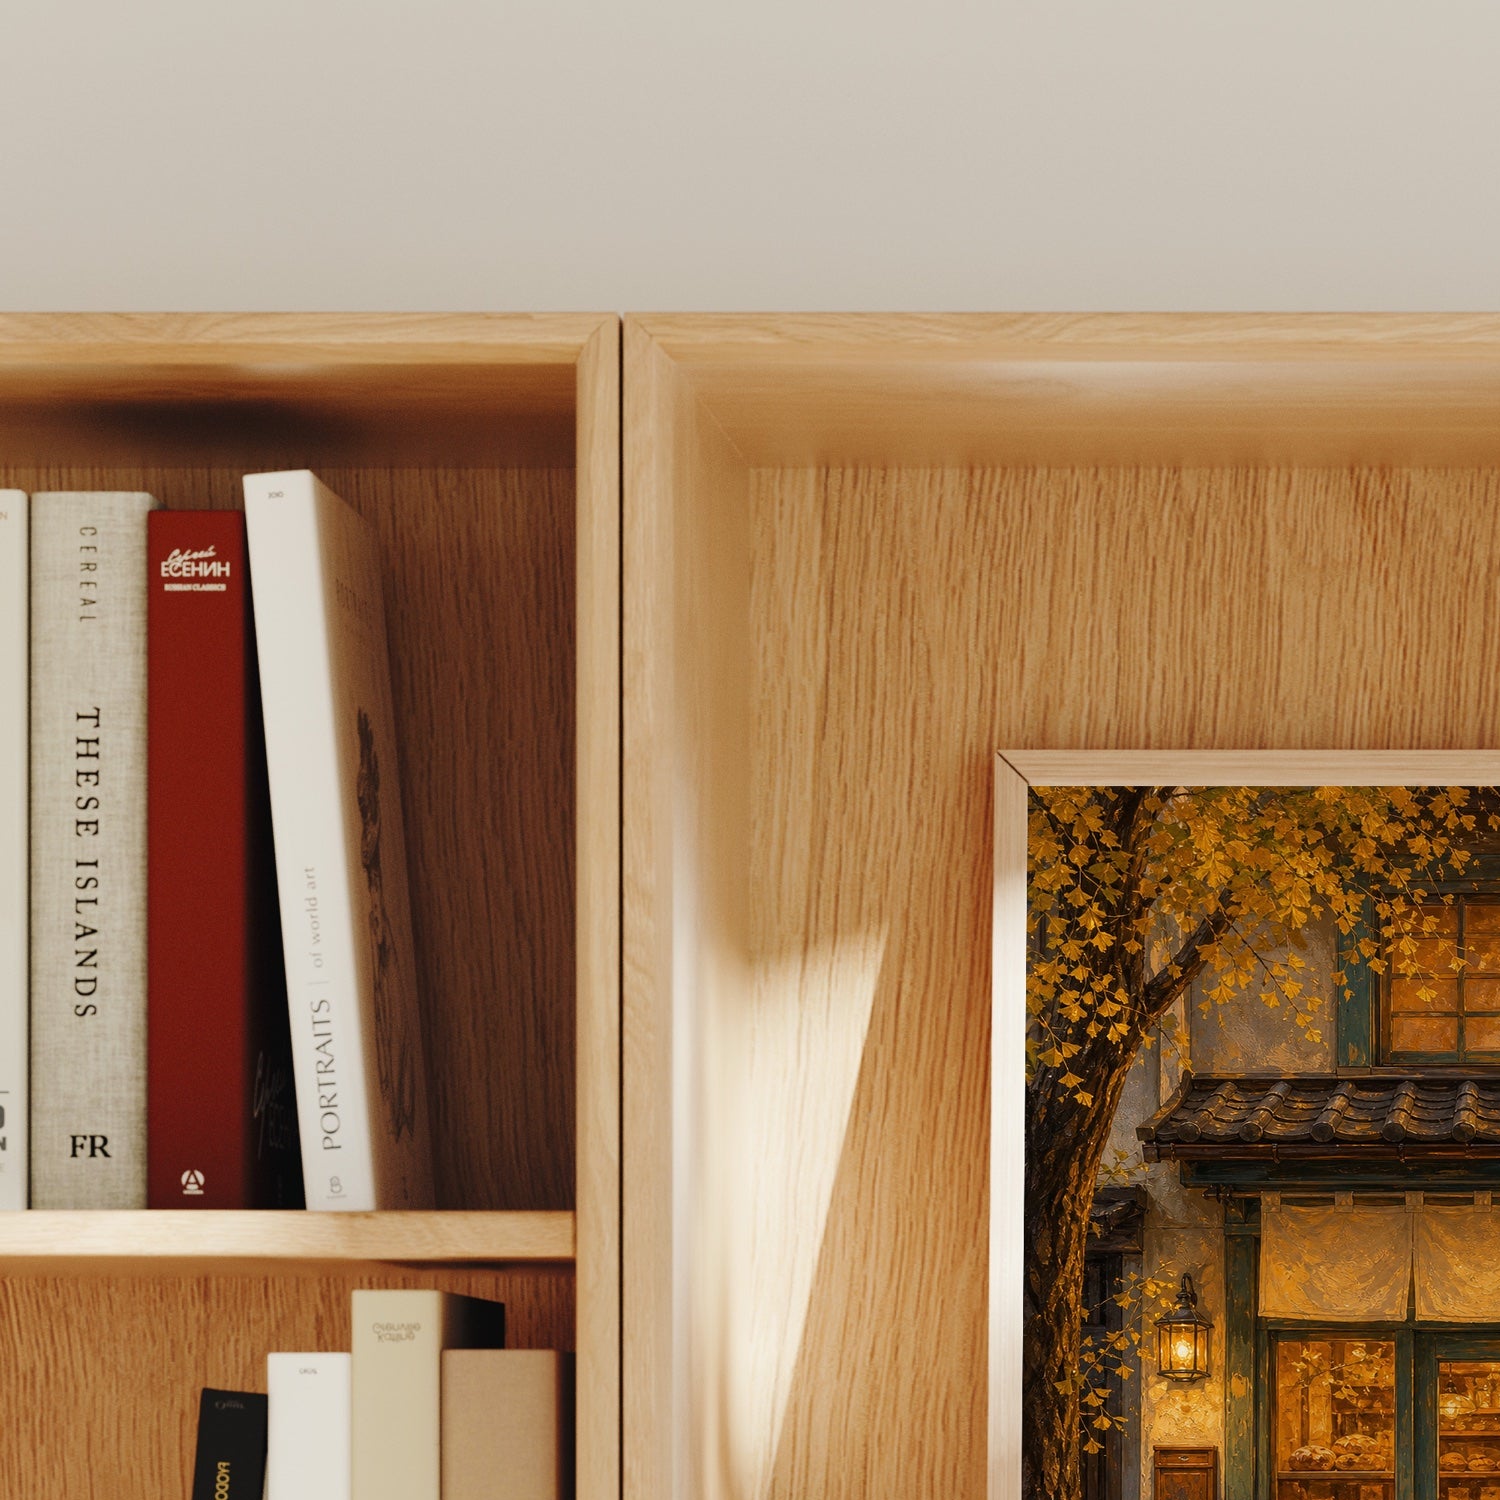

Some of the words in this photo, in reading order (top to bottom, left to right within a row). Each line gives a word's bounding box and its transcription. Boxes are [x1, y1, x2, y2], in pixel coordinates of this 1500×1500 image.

[79, 526, 97, 622] CEREAL
[160, 561, 231, 577] ЕСЕНИН
[76, 707, 100, 837] THESE
[304, 867, 317, 890] art
[74, 860, 99, 1017] ISLANDS
[304, 897, 321, 944] world
[313, 952, 324, 968] of
[310, 999, 342, 1150] PORTRAITS
[69, 1134, 112, 1158] FR
